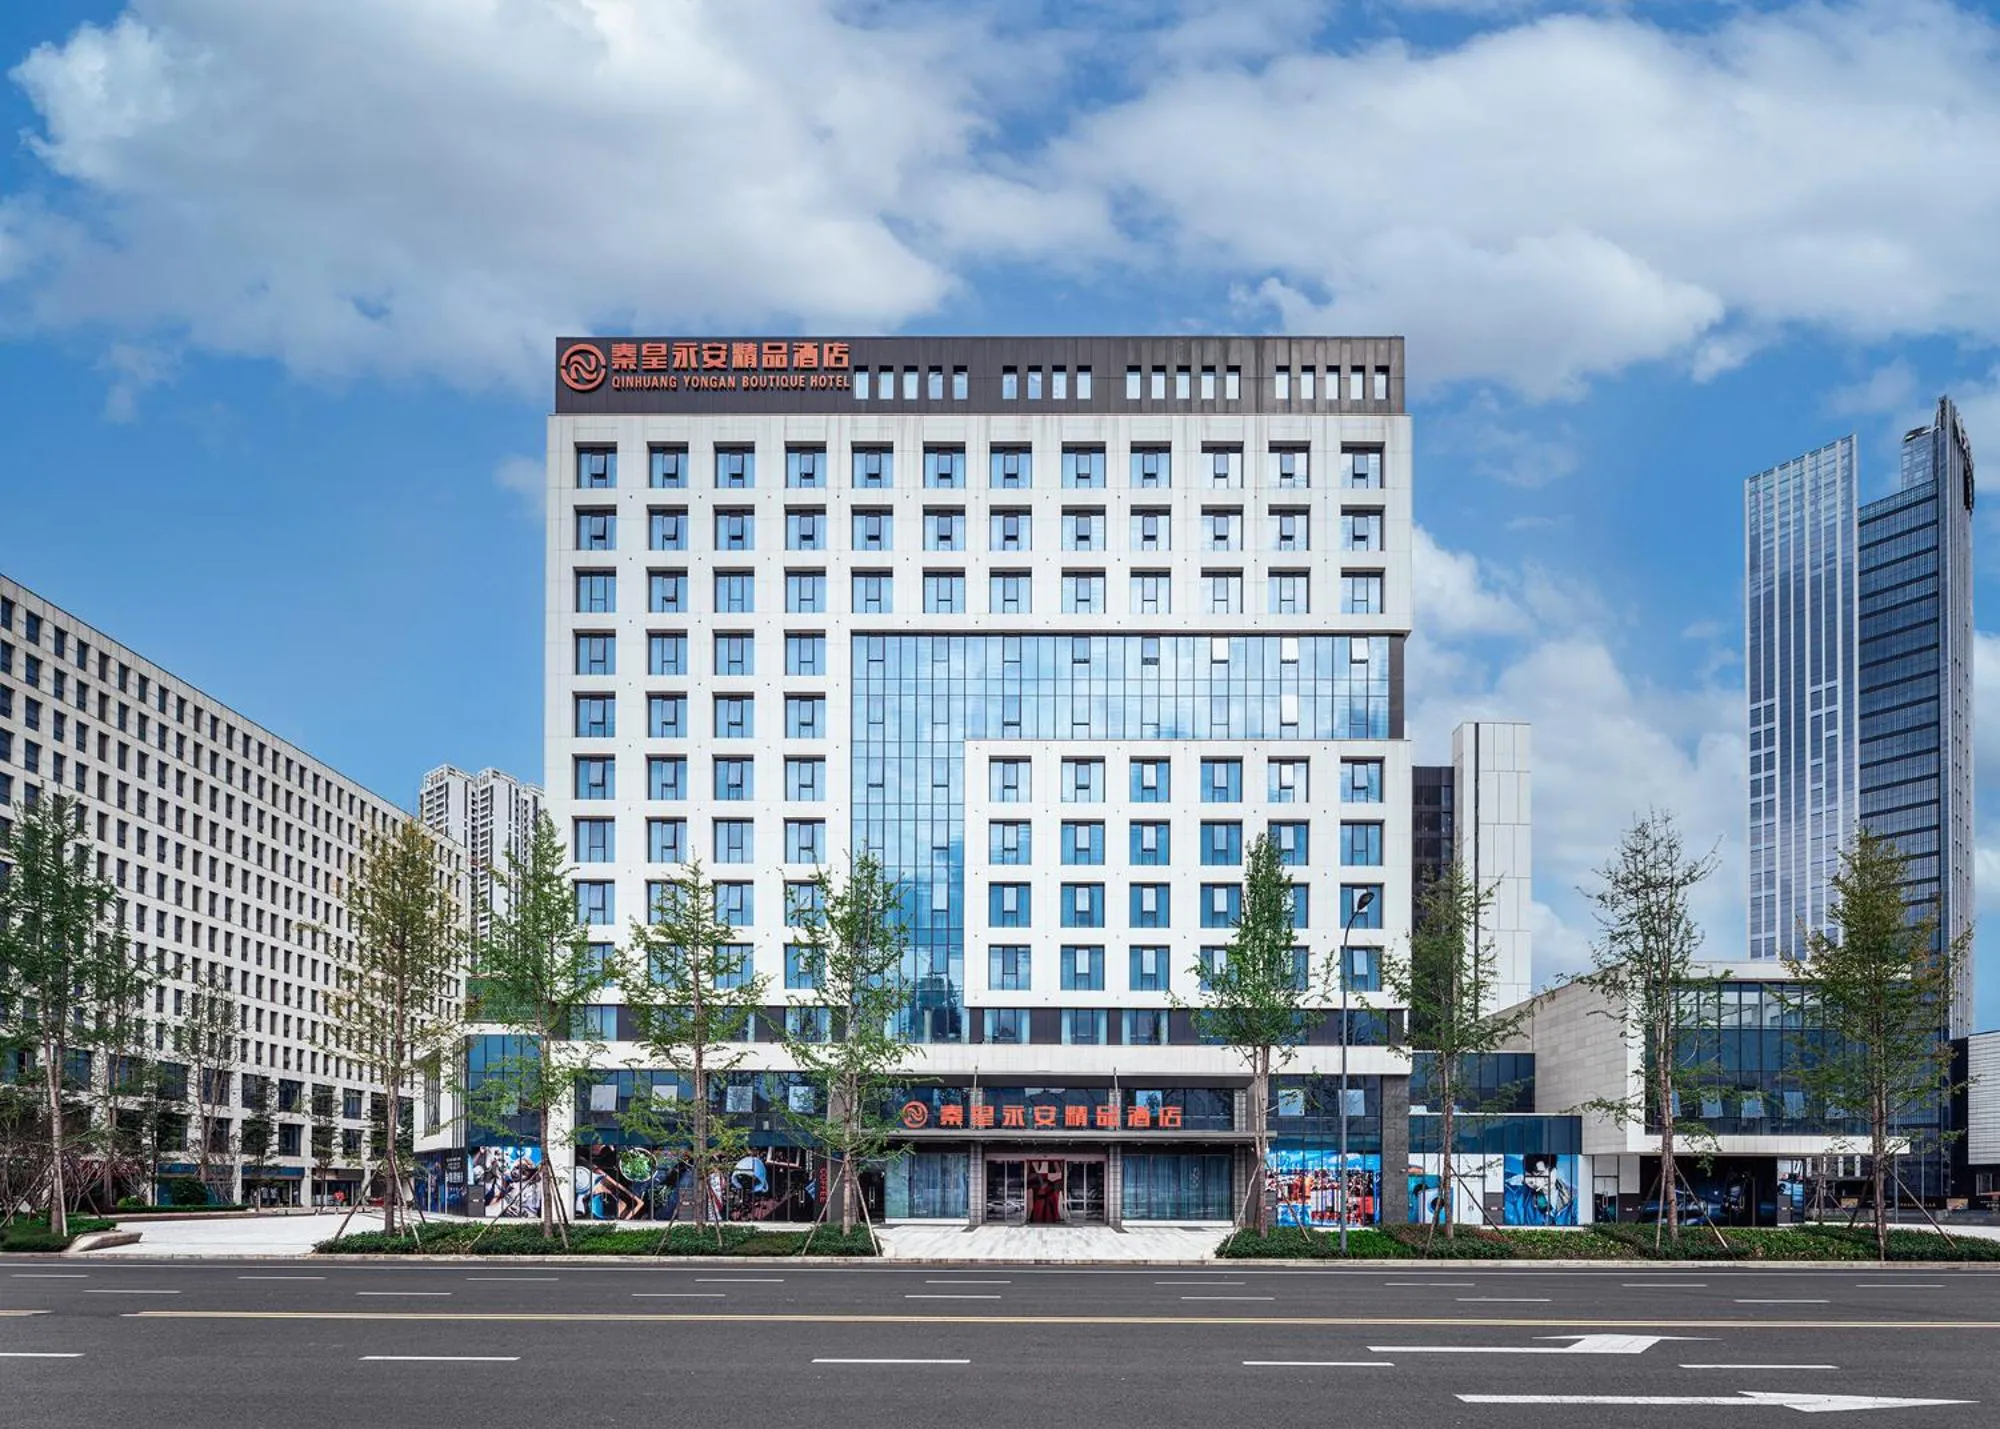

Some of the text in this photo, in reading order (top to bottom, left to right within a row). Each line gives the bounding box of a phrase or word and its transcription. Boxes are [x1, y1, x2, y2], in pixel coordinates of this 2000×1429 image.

[611, 342, 850, 369] 秦皇永安精品酒店
[611, 375, 851, 389] QINHUANG YONGAN BOUTIQUE HOTEL
[939, 1104, 1182, 1127] 秦皇永安精品酒店
